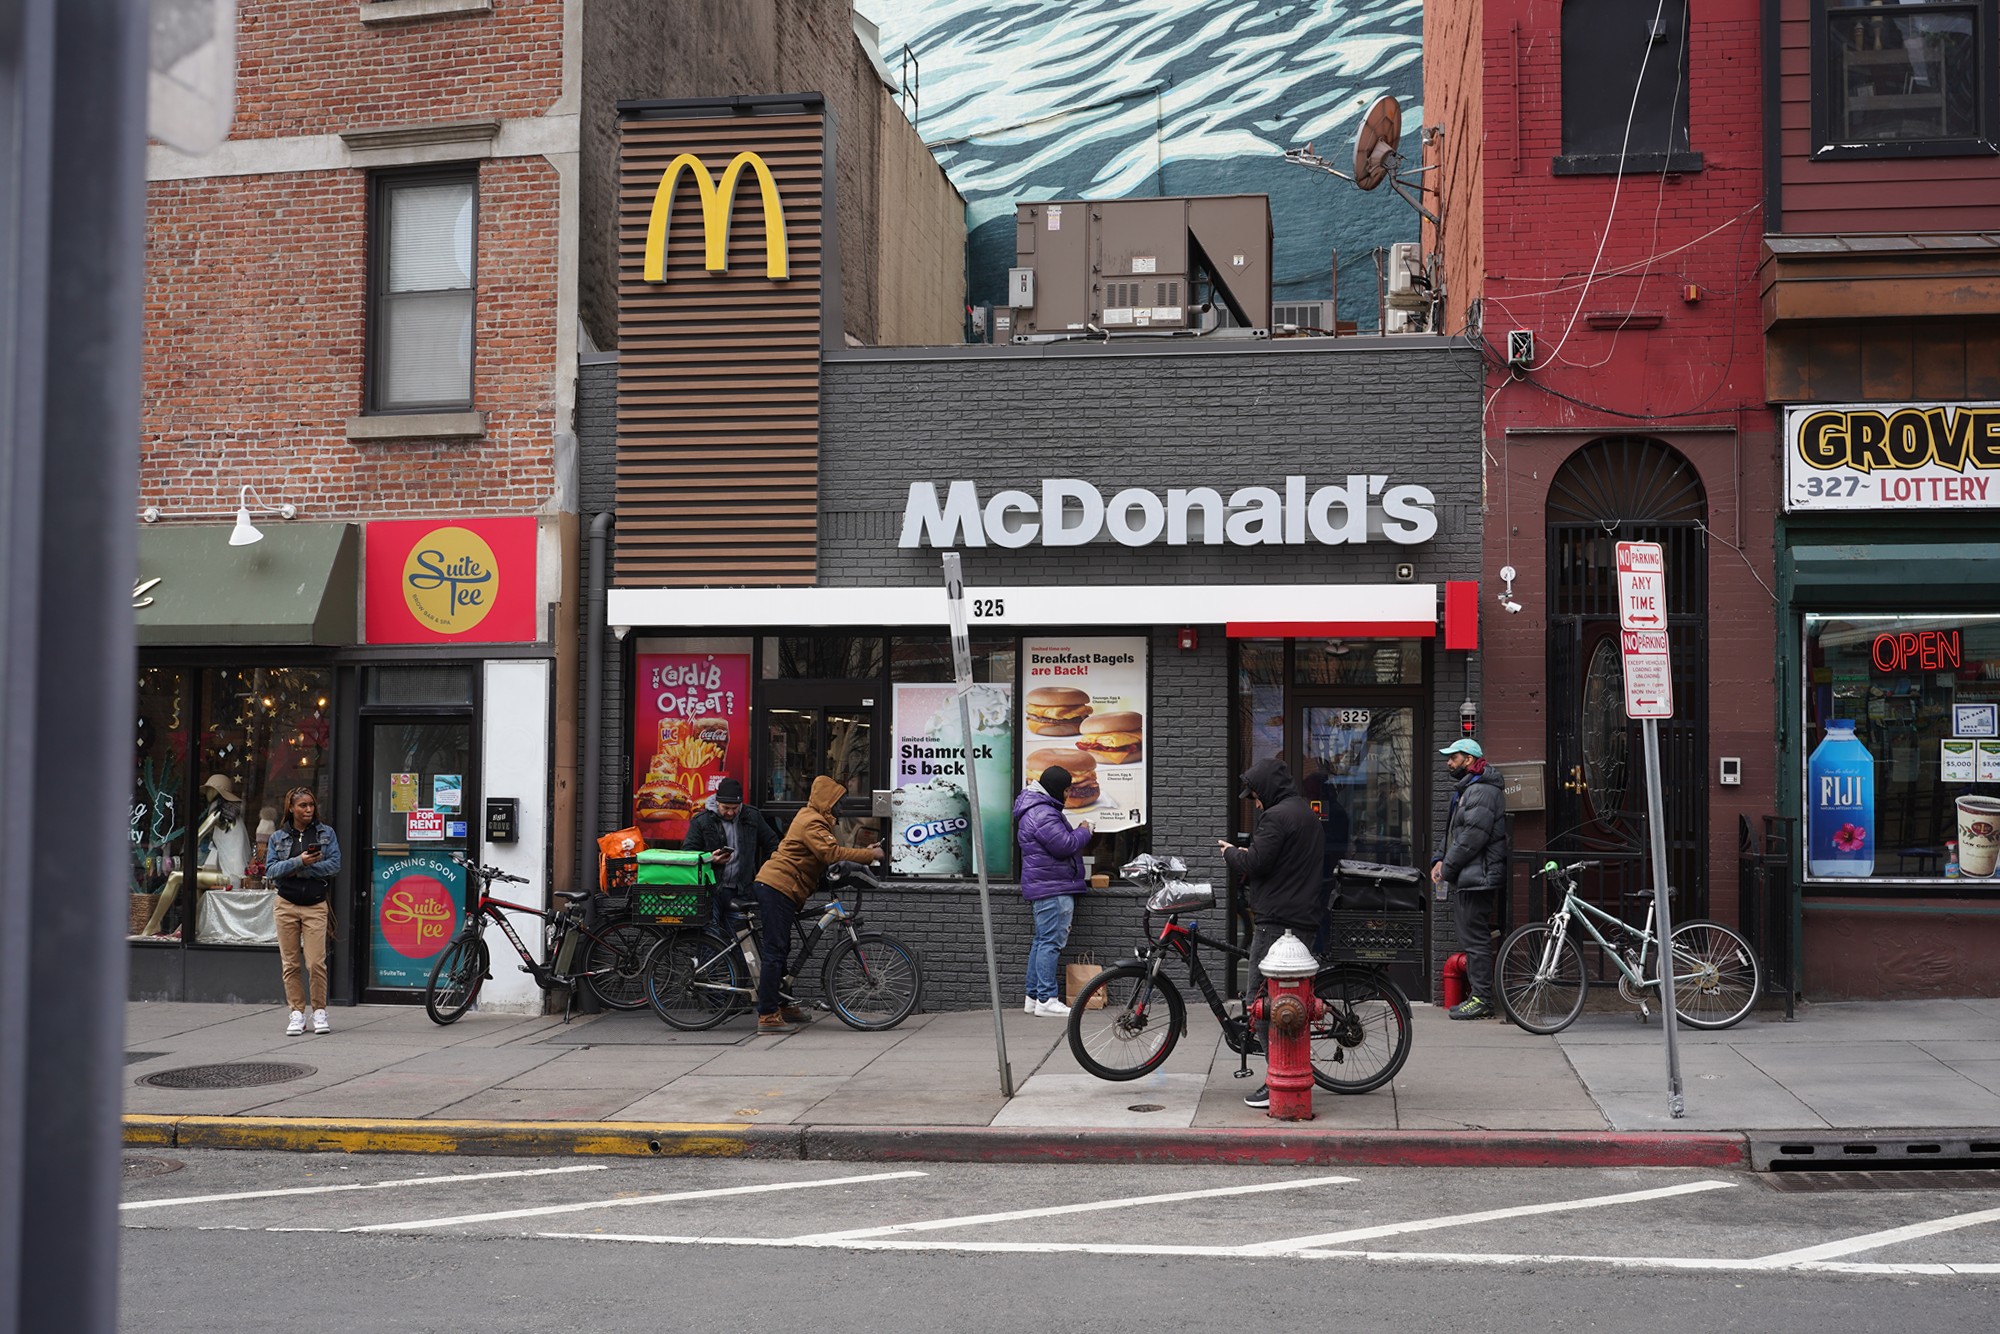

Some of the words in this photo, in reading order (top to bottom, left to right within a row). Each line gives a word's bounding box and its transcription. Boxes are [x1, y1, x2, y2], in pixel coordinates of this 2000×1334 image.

[1797, 406, 2000, 475] GROVE
[1880, 476, 1990, 502] LOTTERY
[898, 474, 1438, 548] McDonald's
[1619, 549, 1630, 566] NO
[1631, 552, 1660, 565] PARKING
[409, 550, 482, 589] Suite
[1631, 576, 1652, 590] ANY
[974, 599, 1004, 617] 325
[1630, 596, 1655, 610] TIME
[1624, 634, 1638, 650] NO
[1638, 636, 1666, 649] PARKING
[1031, 653, 1091, 664] Breakfast
[1093, 653, 1135, 666] Bagels
[1872, 630, 1961, 672] OPEN
[1031, 667, 1051, 676] are
[1054, 665, 1088, 676] Back!
[1342, 711, 1369, 722] 325
[901, 760, 917, 775] is
[921, 760, 965, 775] back
[1820, 776, 1863, 806] FIJI
[410, 819, 441, 829] RENT
[416, 812, 435, 820] FOR
[906, 818, 968, 843] OREO
[382, 858, 426, 880] OPENING
[428, 860, 457, 882] SOON
[385, 891, 444, 923] Suite
